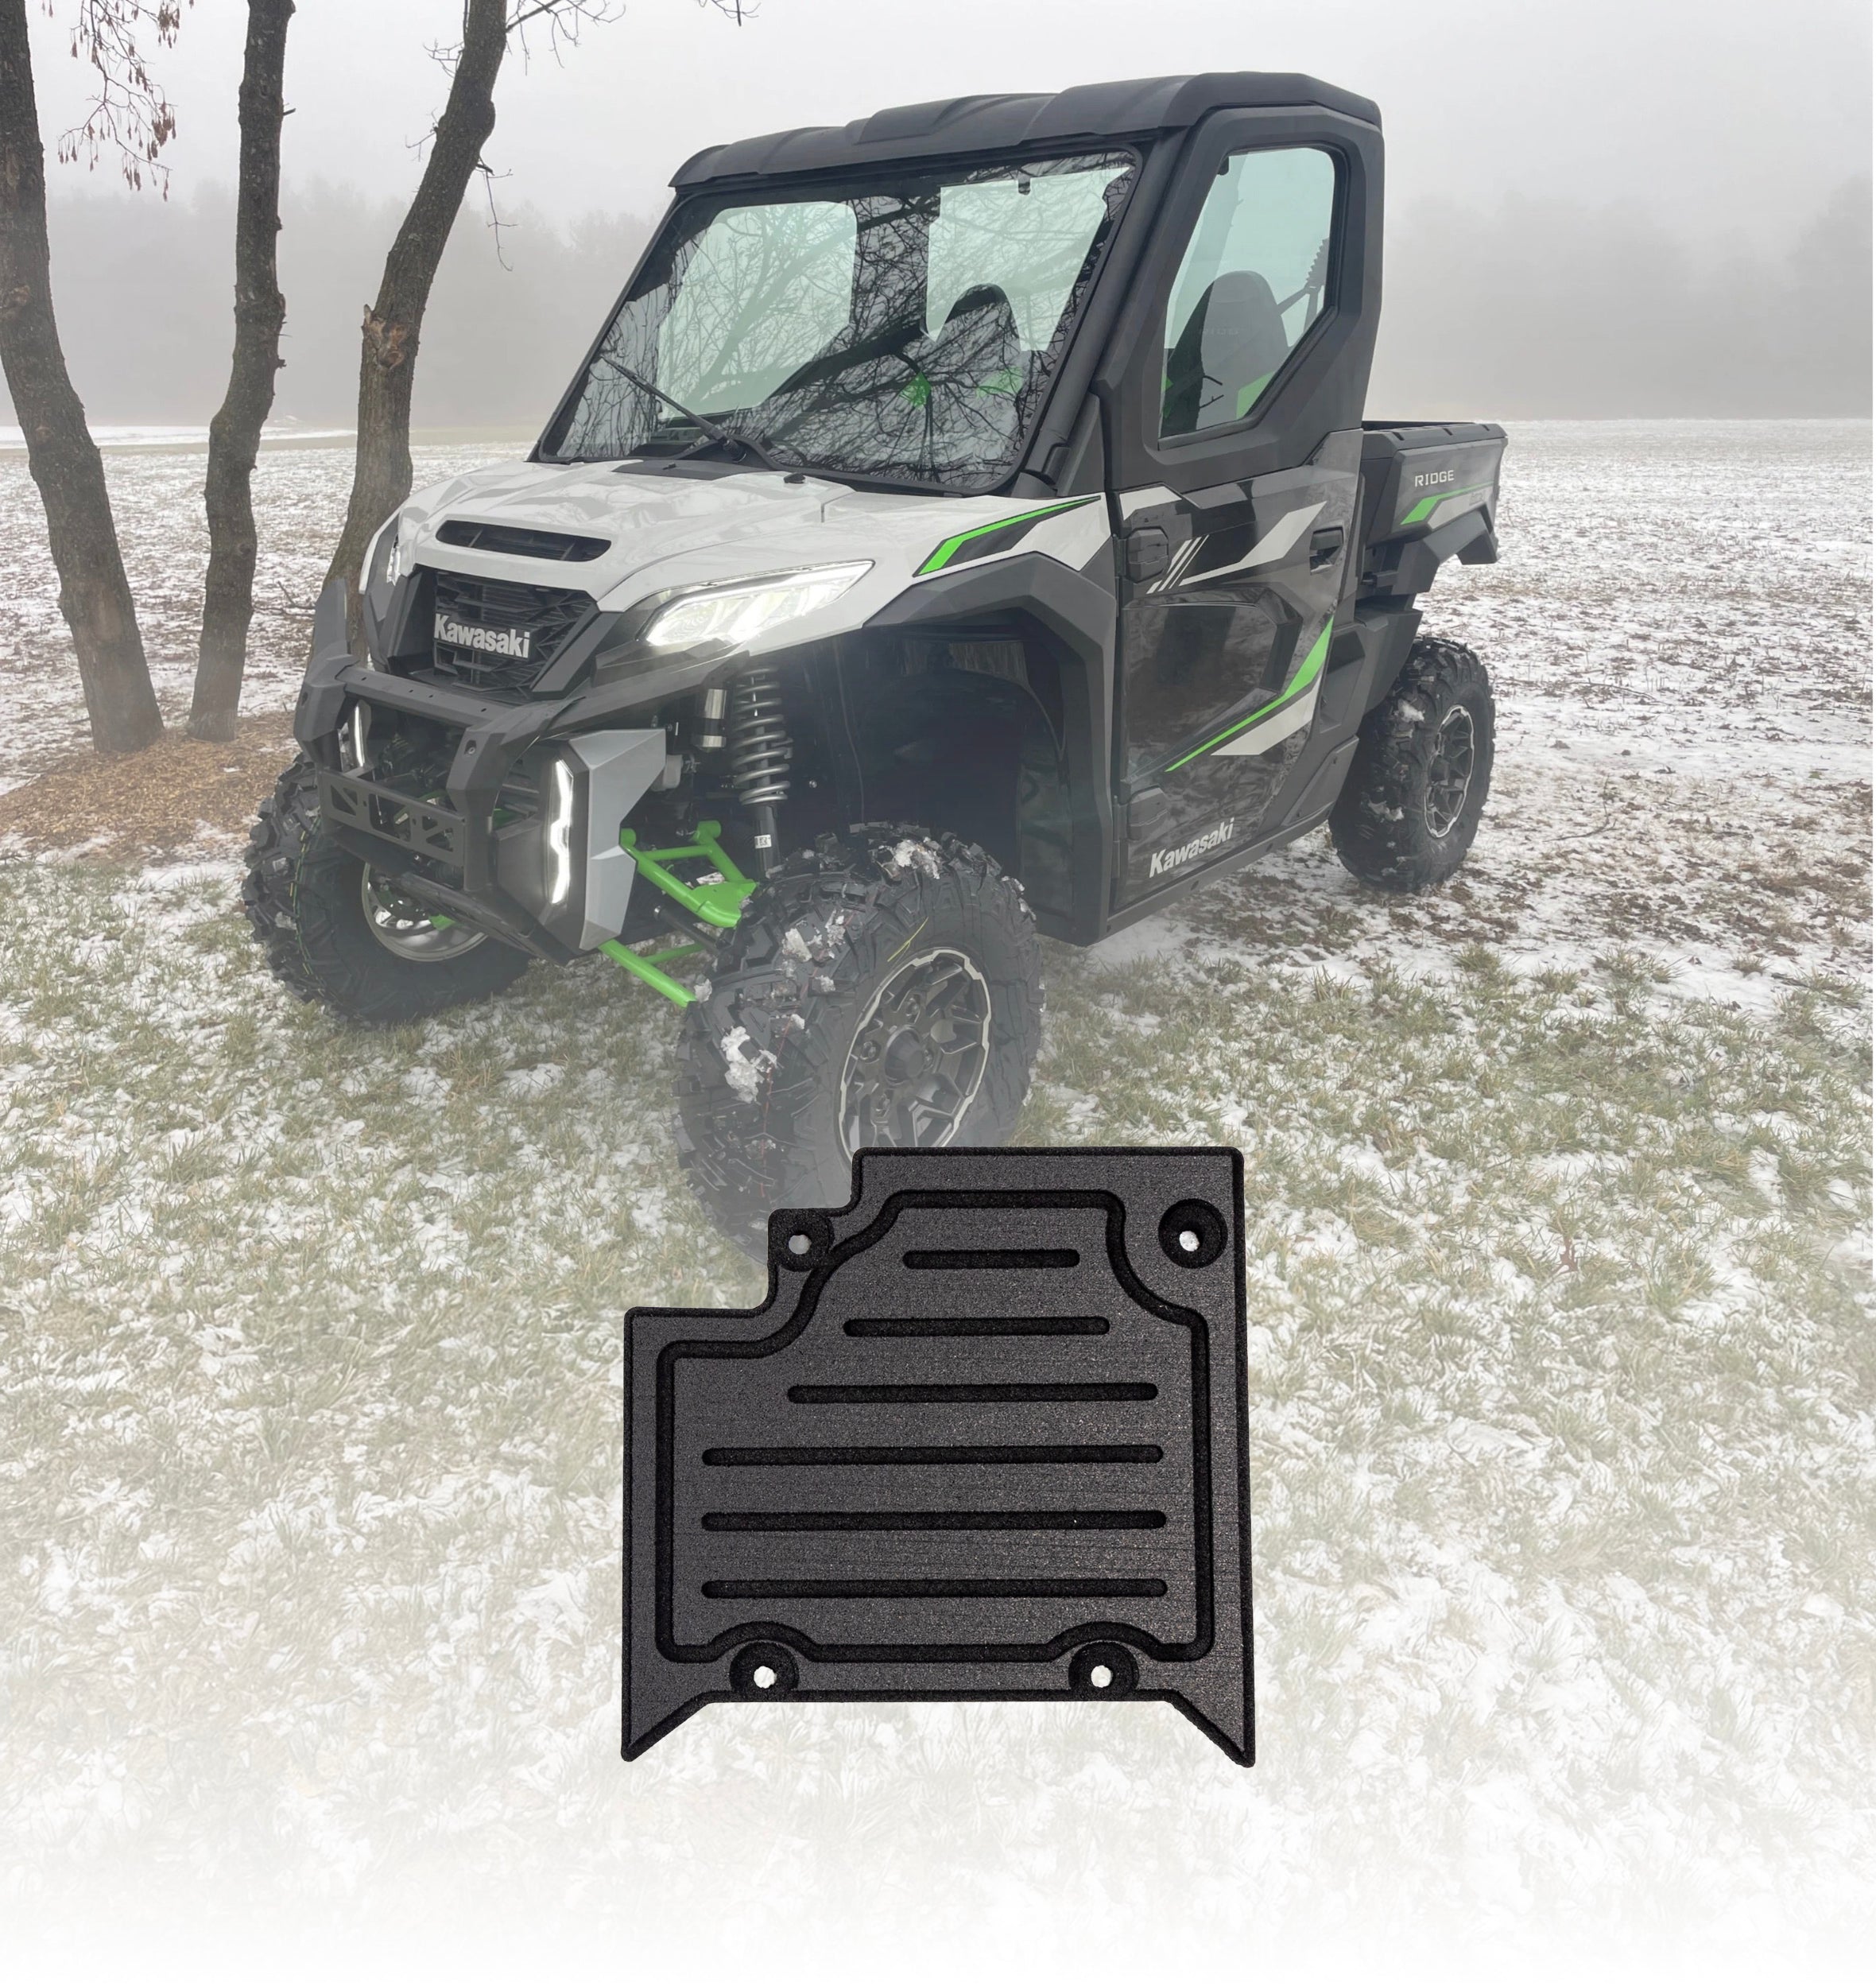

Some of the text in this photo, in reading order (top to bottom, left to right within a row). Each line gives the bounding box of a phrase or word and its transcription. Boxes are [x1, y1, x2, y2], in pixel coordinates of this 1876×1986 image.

[1415, 470, 1454, 487] RIDGE
[434, 613, 530, 658] Kawasaki
[1149, 817, 1235, 878] Kawasaki
